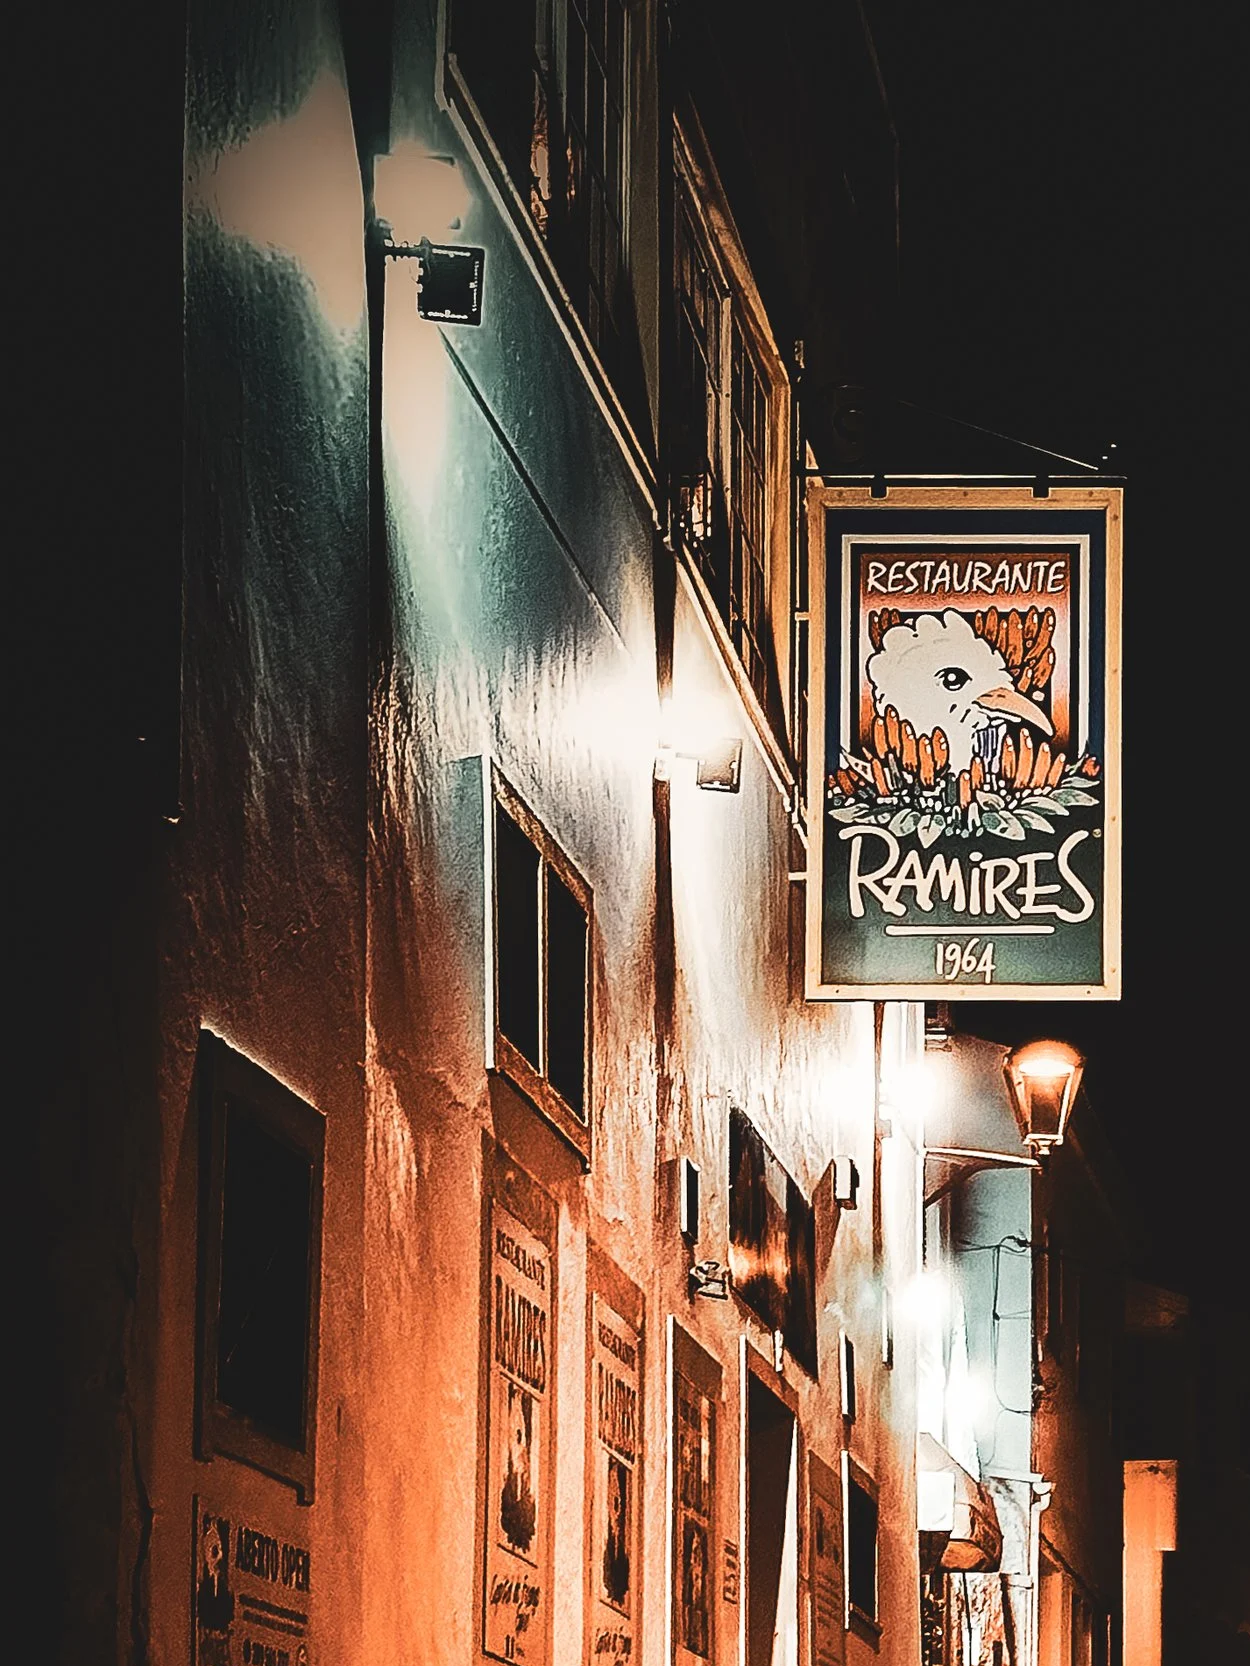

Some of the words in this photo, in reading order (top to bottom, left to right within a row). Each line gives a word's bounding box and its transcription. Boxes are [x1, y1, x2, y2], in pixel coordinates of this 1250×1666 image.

[866, 560, 1066, 595] RESTAURANTE
[935, 936, 996, 983] 1964
[235, 1526, 278, 1584] ABERTO
[281, 1542, 310, 1592] OPEN
